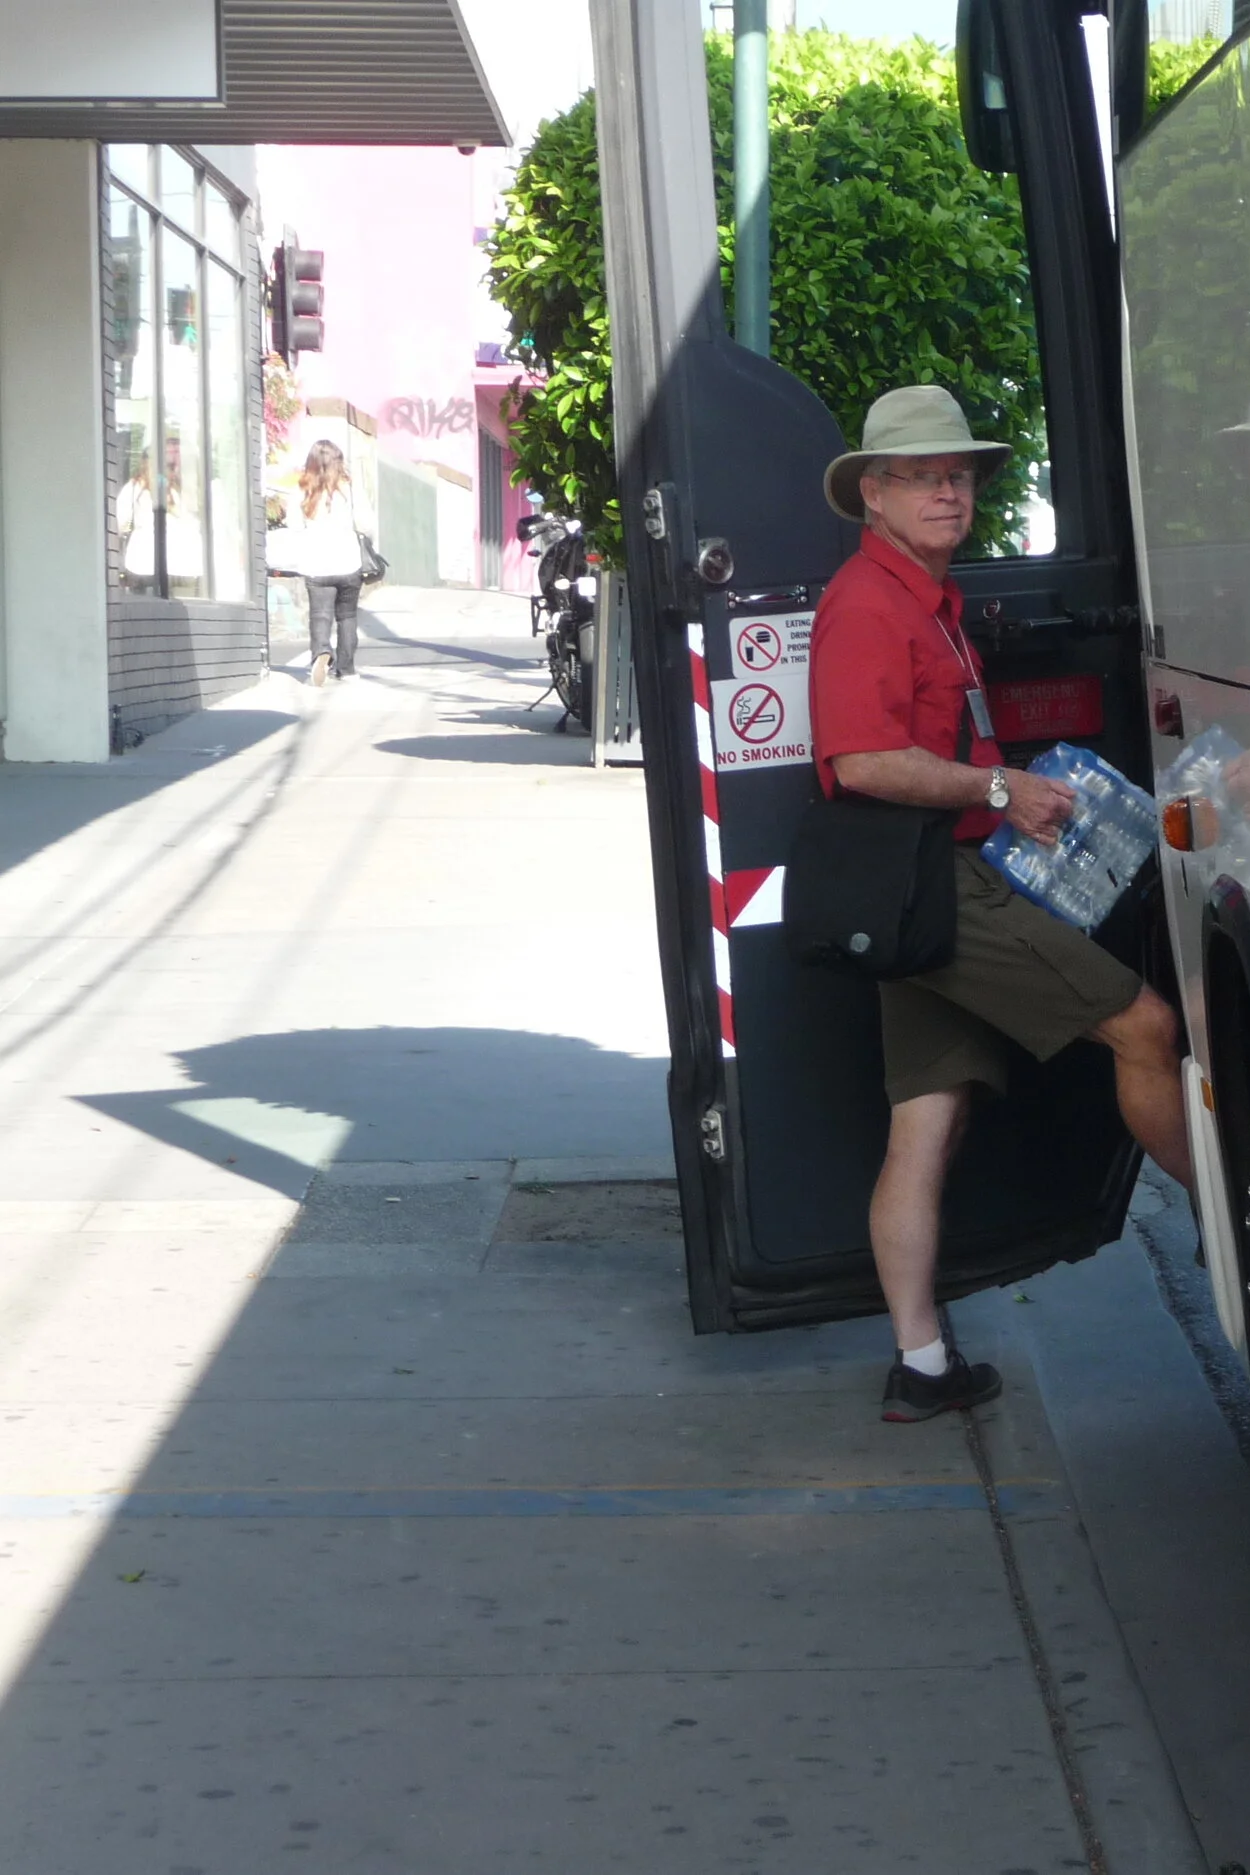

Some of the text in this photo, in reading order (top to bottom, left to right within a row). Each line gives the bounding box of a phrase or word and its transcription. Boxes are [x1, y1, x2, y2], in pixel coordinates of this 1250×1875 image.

[785, 619, 811, 628] EATING
[780, 654, 807, 665] IN THIS
[717, 743, 807, 765] NO SMOKING
